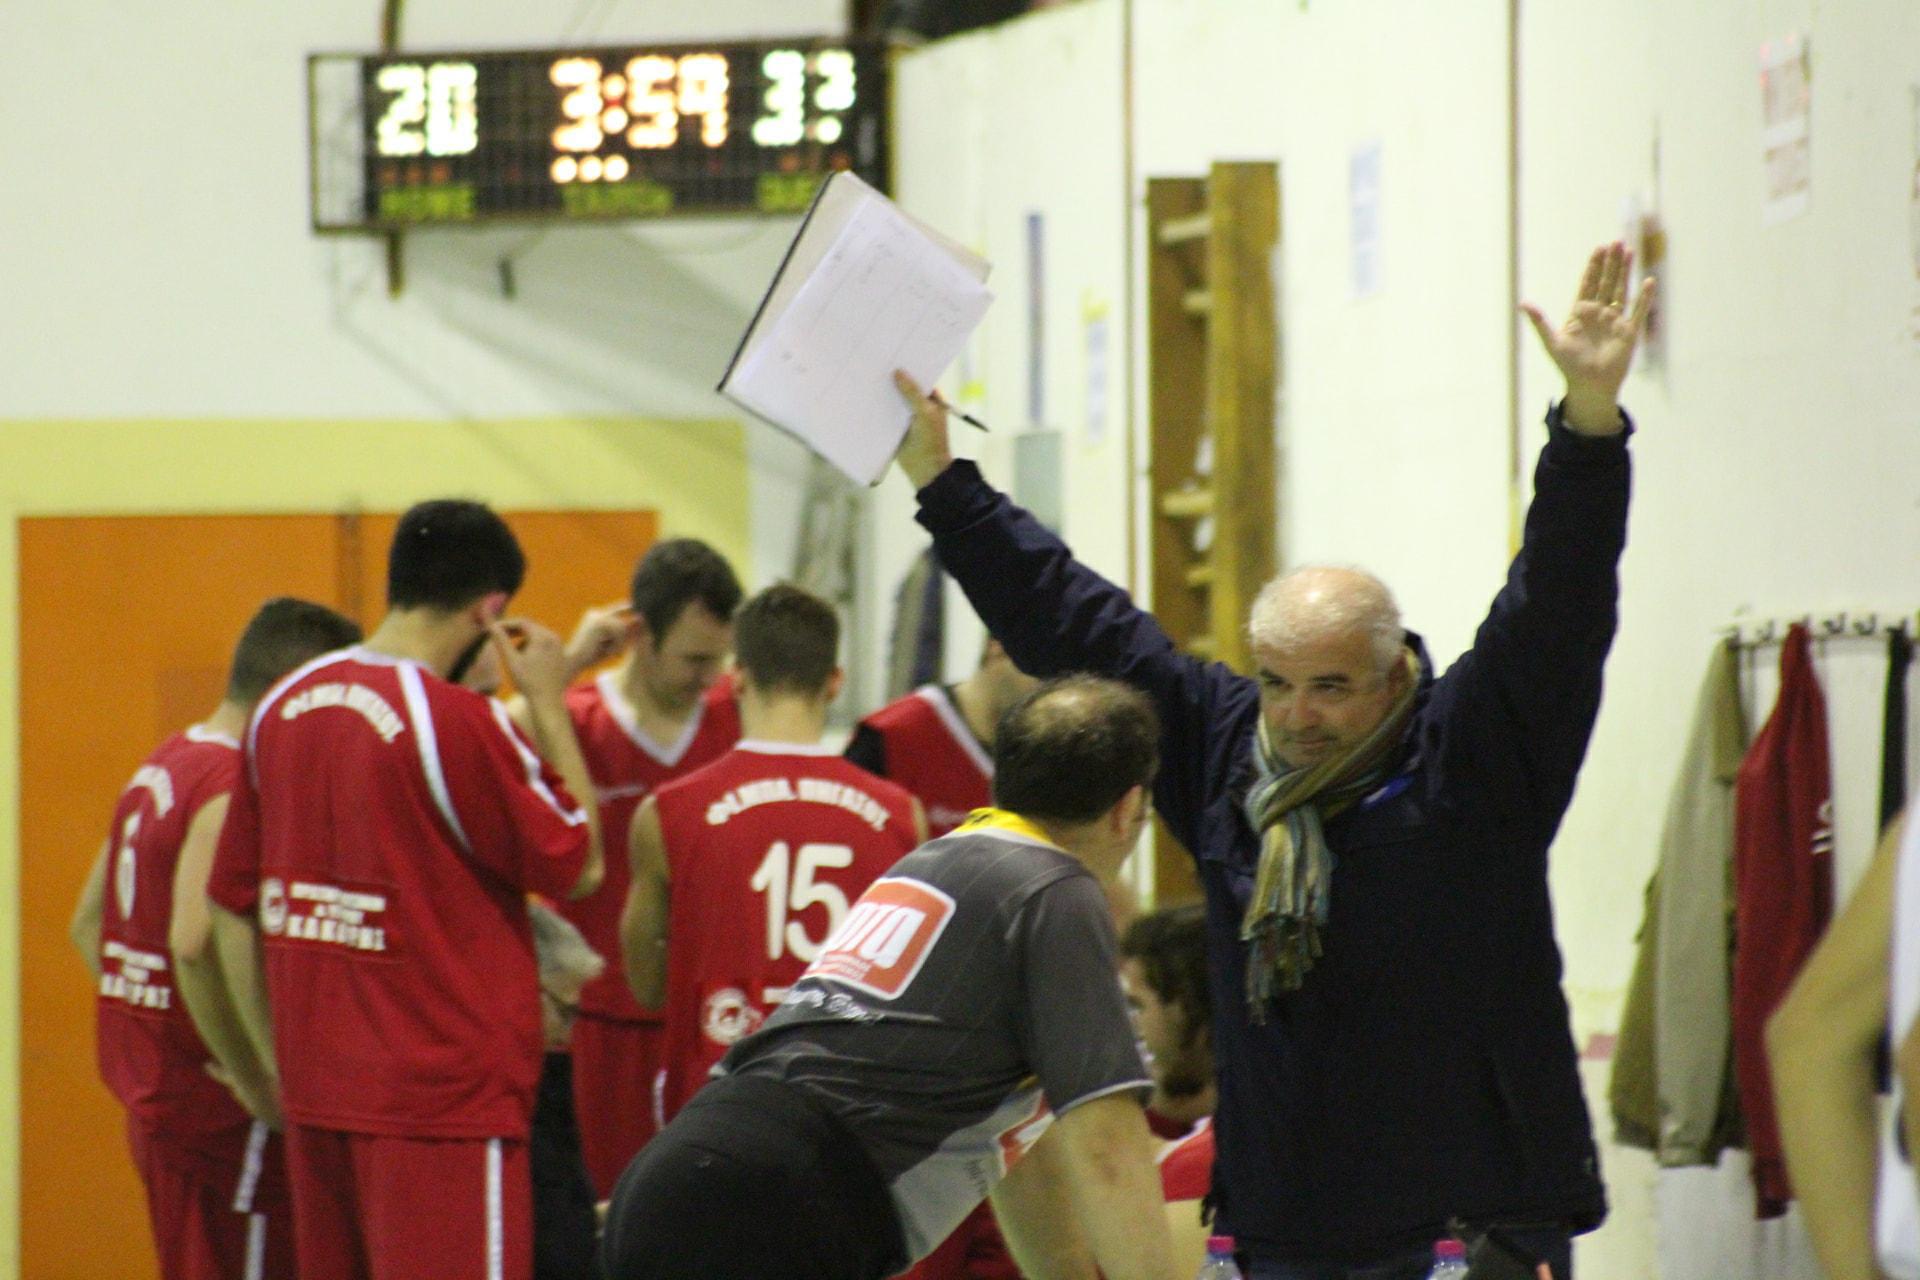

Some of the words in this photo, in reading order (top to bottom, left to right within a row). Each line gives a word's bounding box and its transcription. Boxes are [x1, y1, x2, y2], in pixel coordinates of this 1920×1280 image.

[377, 64, 478, 156] 20
[550, 52, 730, 152] 3:59
[751, 840, 853, 963] 15
